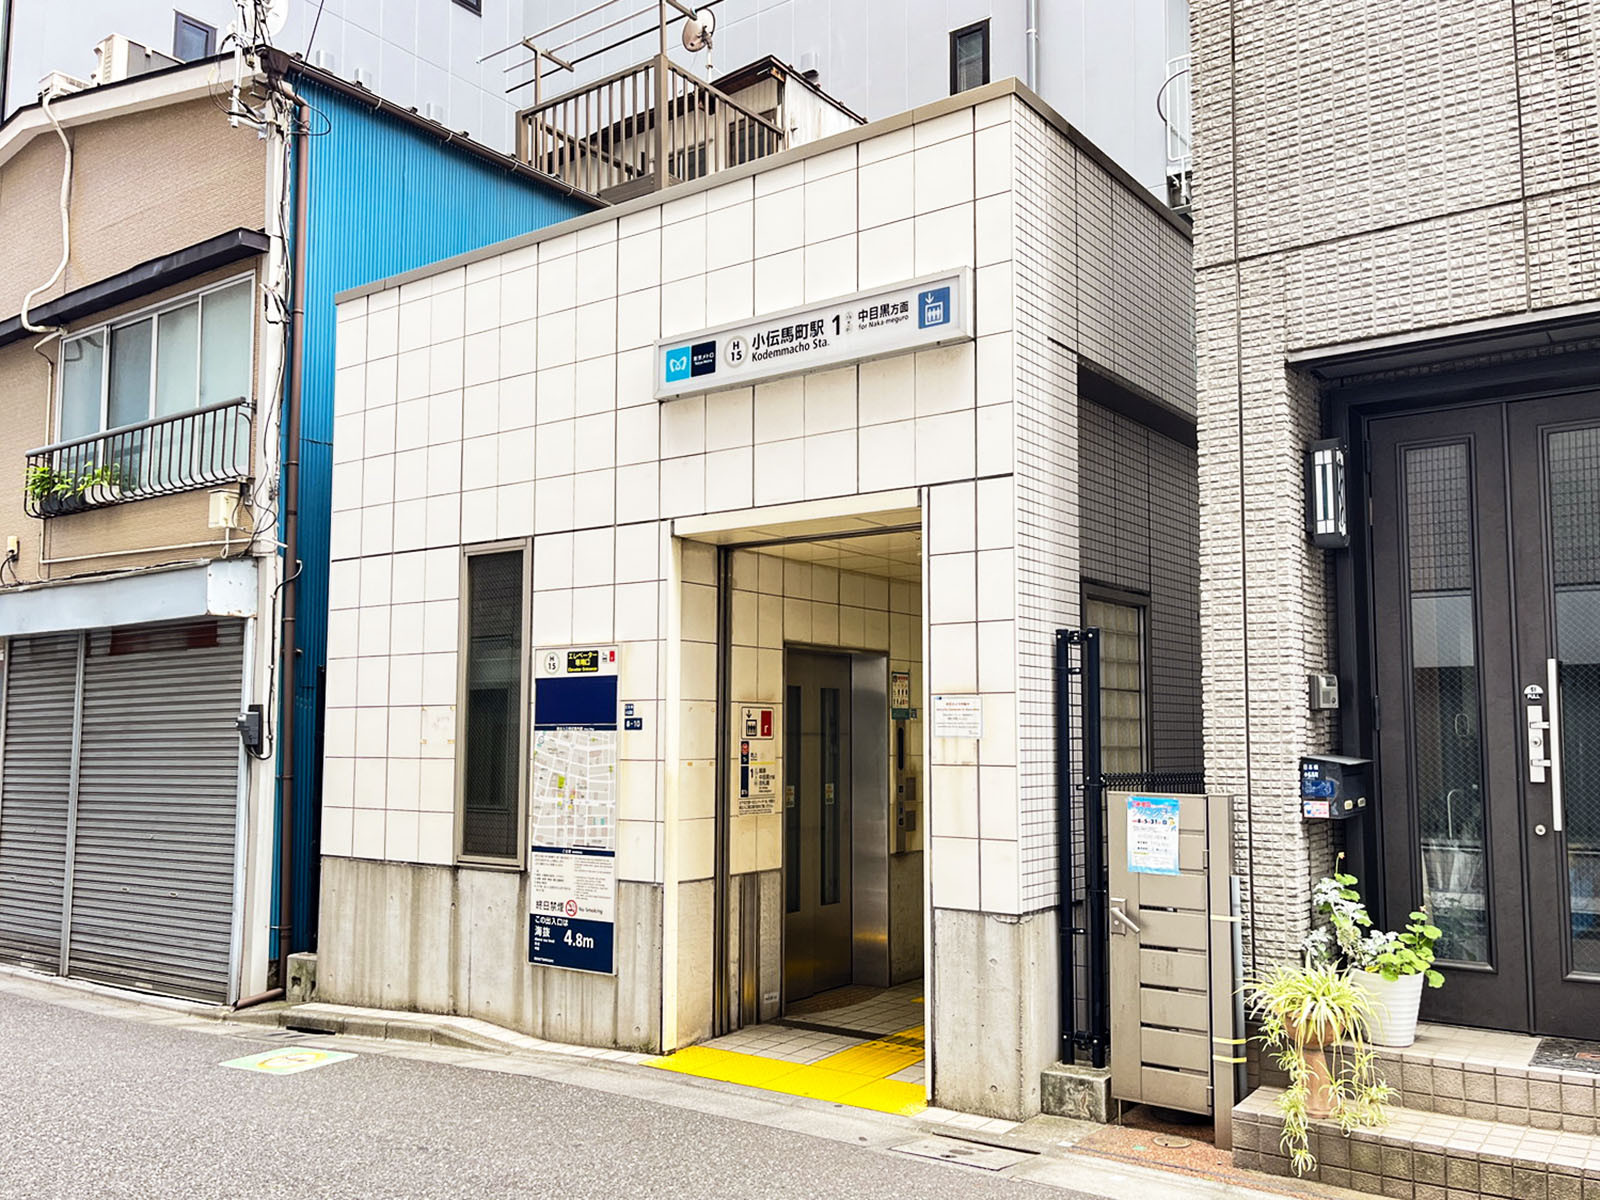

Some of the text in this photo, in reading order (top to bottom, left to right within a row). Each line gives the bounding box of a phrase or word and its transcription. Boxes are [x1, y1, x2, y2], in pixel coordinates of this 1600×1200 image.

[858, 300, 909, 323] 中目黒方面
[858, 322, 868, 330] for
[868, 314, 909, 328] Naka-meguro
[751, 319, 824, 350] 小伝馬町駅
[832, 314, 840, 336] 1
[732, 340, 740, 350] H
[751, 337, 830, 362] Kodemmacho Sta.
[731, 350, 743, 362] 15
[568, 651, 598, 659] エレベーター
[547, 663, 556, 671] 15
[534, 915, 569, 927] この出入口は
[563, 929, 594, 949] 4.8m
